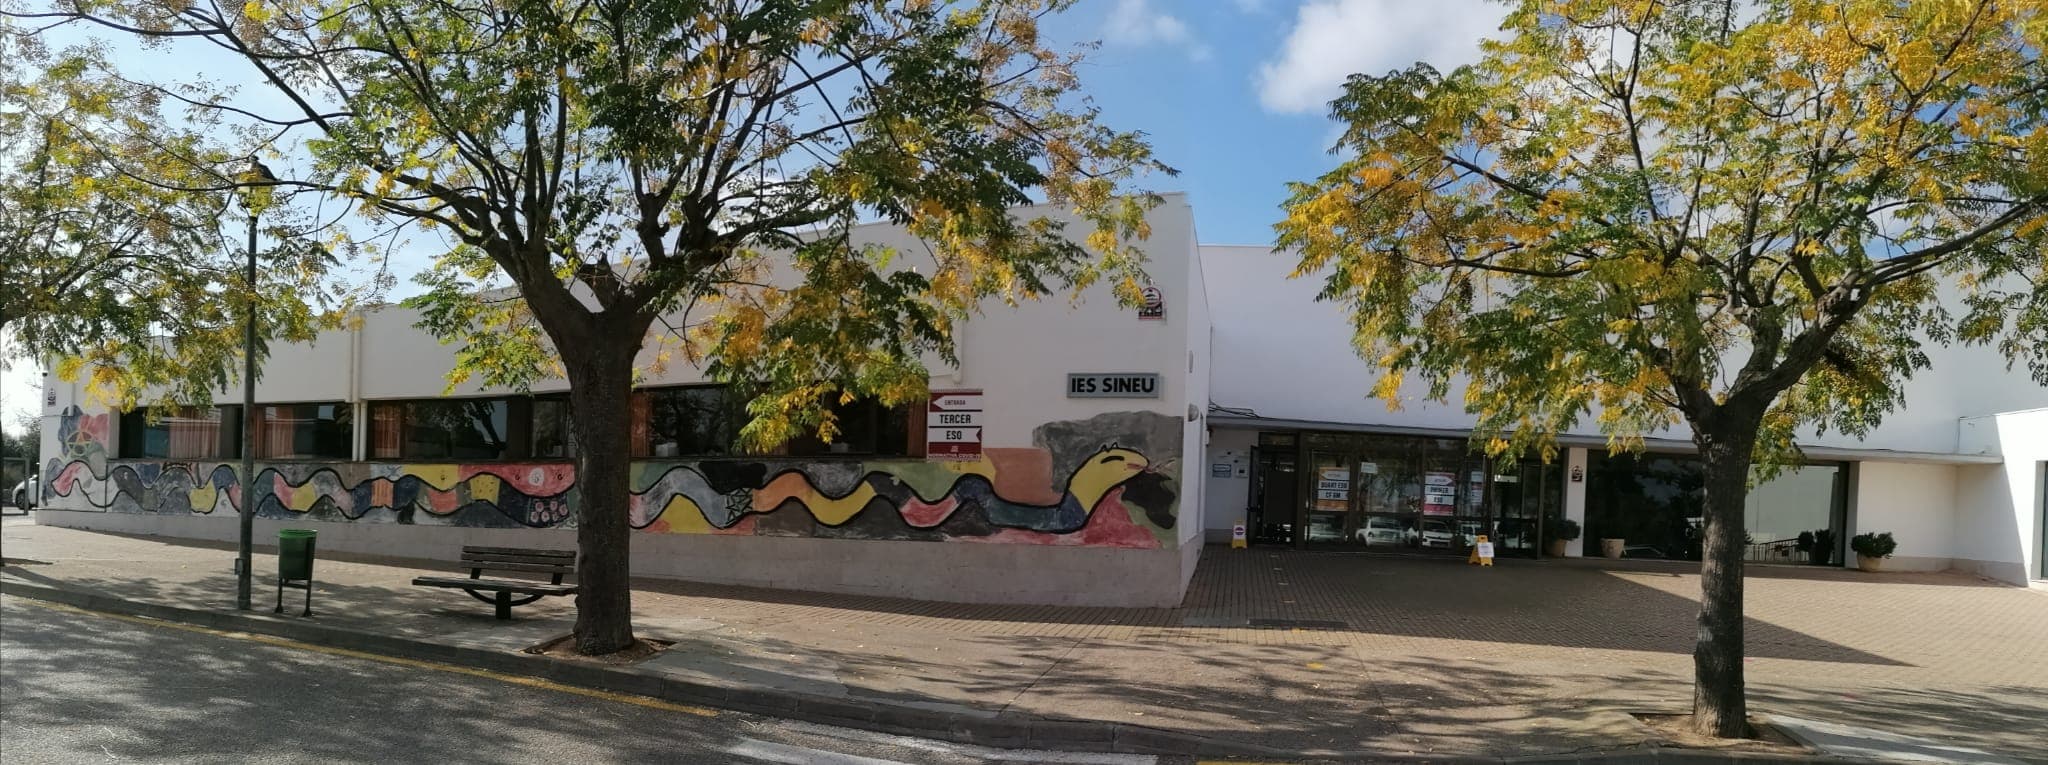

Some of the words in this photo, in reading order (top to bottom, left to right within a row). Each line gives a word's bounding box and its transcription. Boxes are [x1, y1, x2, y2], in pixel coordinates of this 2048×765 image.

[1071, 377, 1096, 393] IES
[1102, 377, 1155, 393] SINEU
[939, 414, 972, 424] TERCER
[946, 430, 962, 440] ESO
